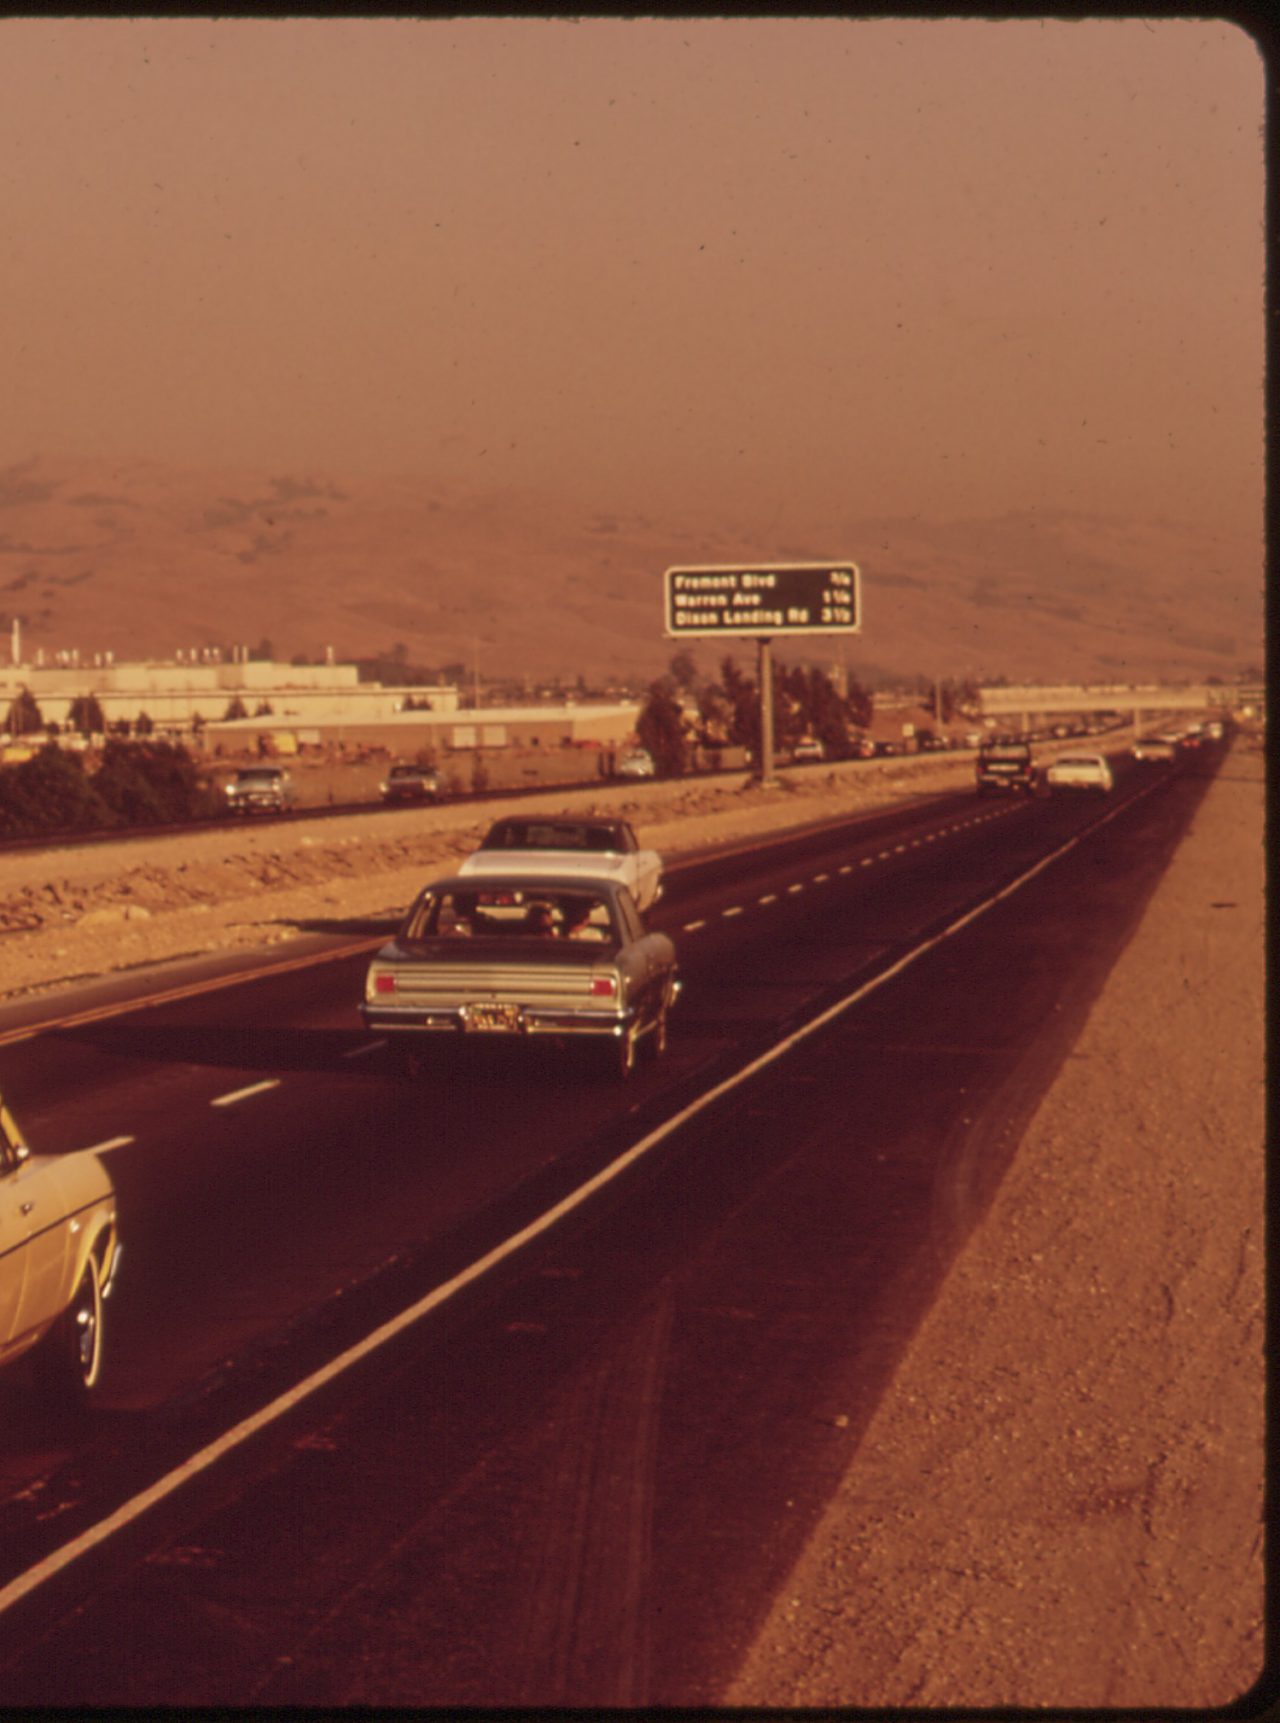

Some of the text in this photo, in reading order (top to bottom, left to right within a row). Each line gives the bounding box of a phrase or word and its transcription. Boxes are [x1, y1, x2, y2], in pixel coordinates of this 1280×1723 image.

[674, 575, 737, 589] Fremont
[741, 573, 776, 589] Blvd
[674, 593, 728, 607] Warren
[732, 592, 761, 606] Ave
[675, 610, 718, 626] Dixon
[722, 609, 782, 626] Landing
[787, 607, 809, 623] Rd
